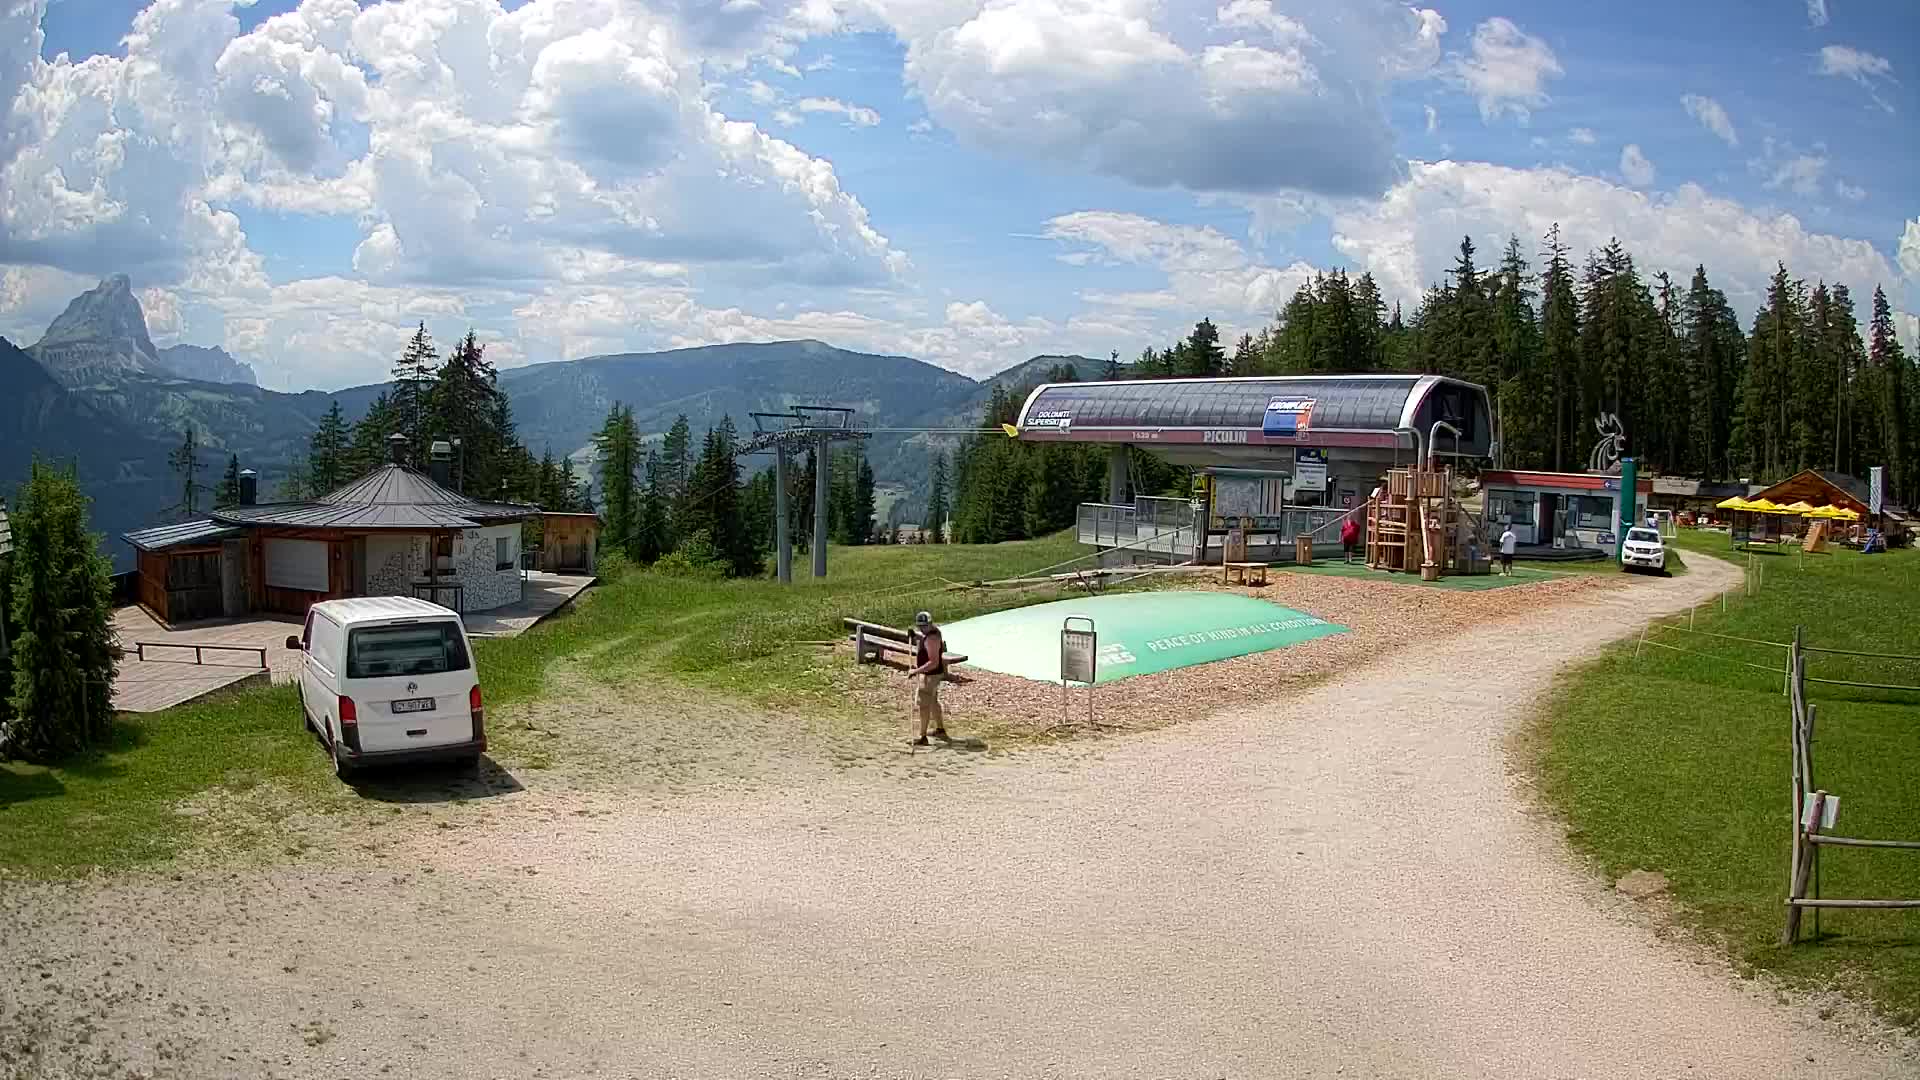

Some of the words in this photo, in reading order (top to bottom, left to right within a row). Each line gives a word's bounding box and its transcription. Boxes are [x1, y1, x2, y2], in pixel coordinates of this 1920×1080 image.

[1038, 410, 1071, 418] DOLOMITI
[1203, 430, 1248, 443] PICULIN
[1146, 636, 1191, 653] PEACE
[1190, 632, 1208, 644] OF
[1208, 628, 1238, 642] MIND
[1237, 627, 1251, 637] IN
[1251, 624, 1272, 636] ALL
